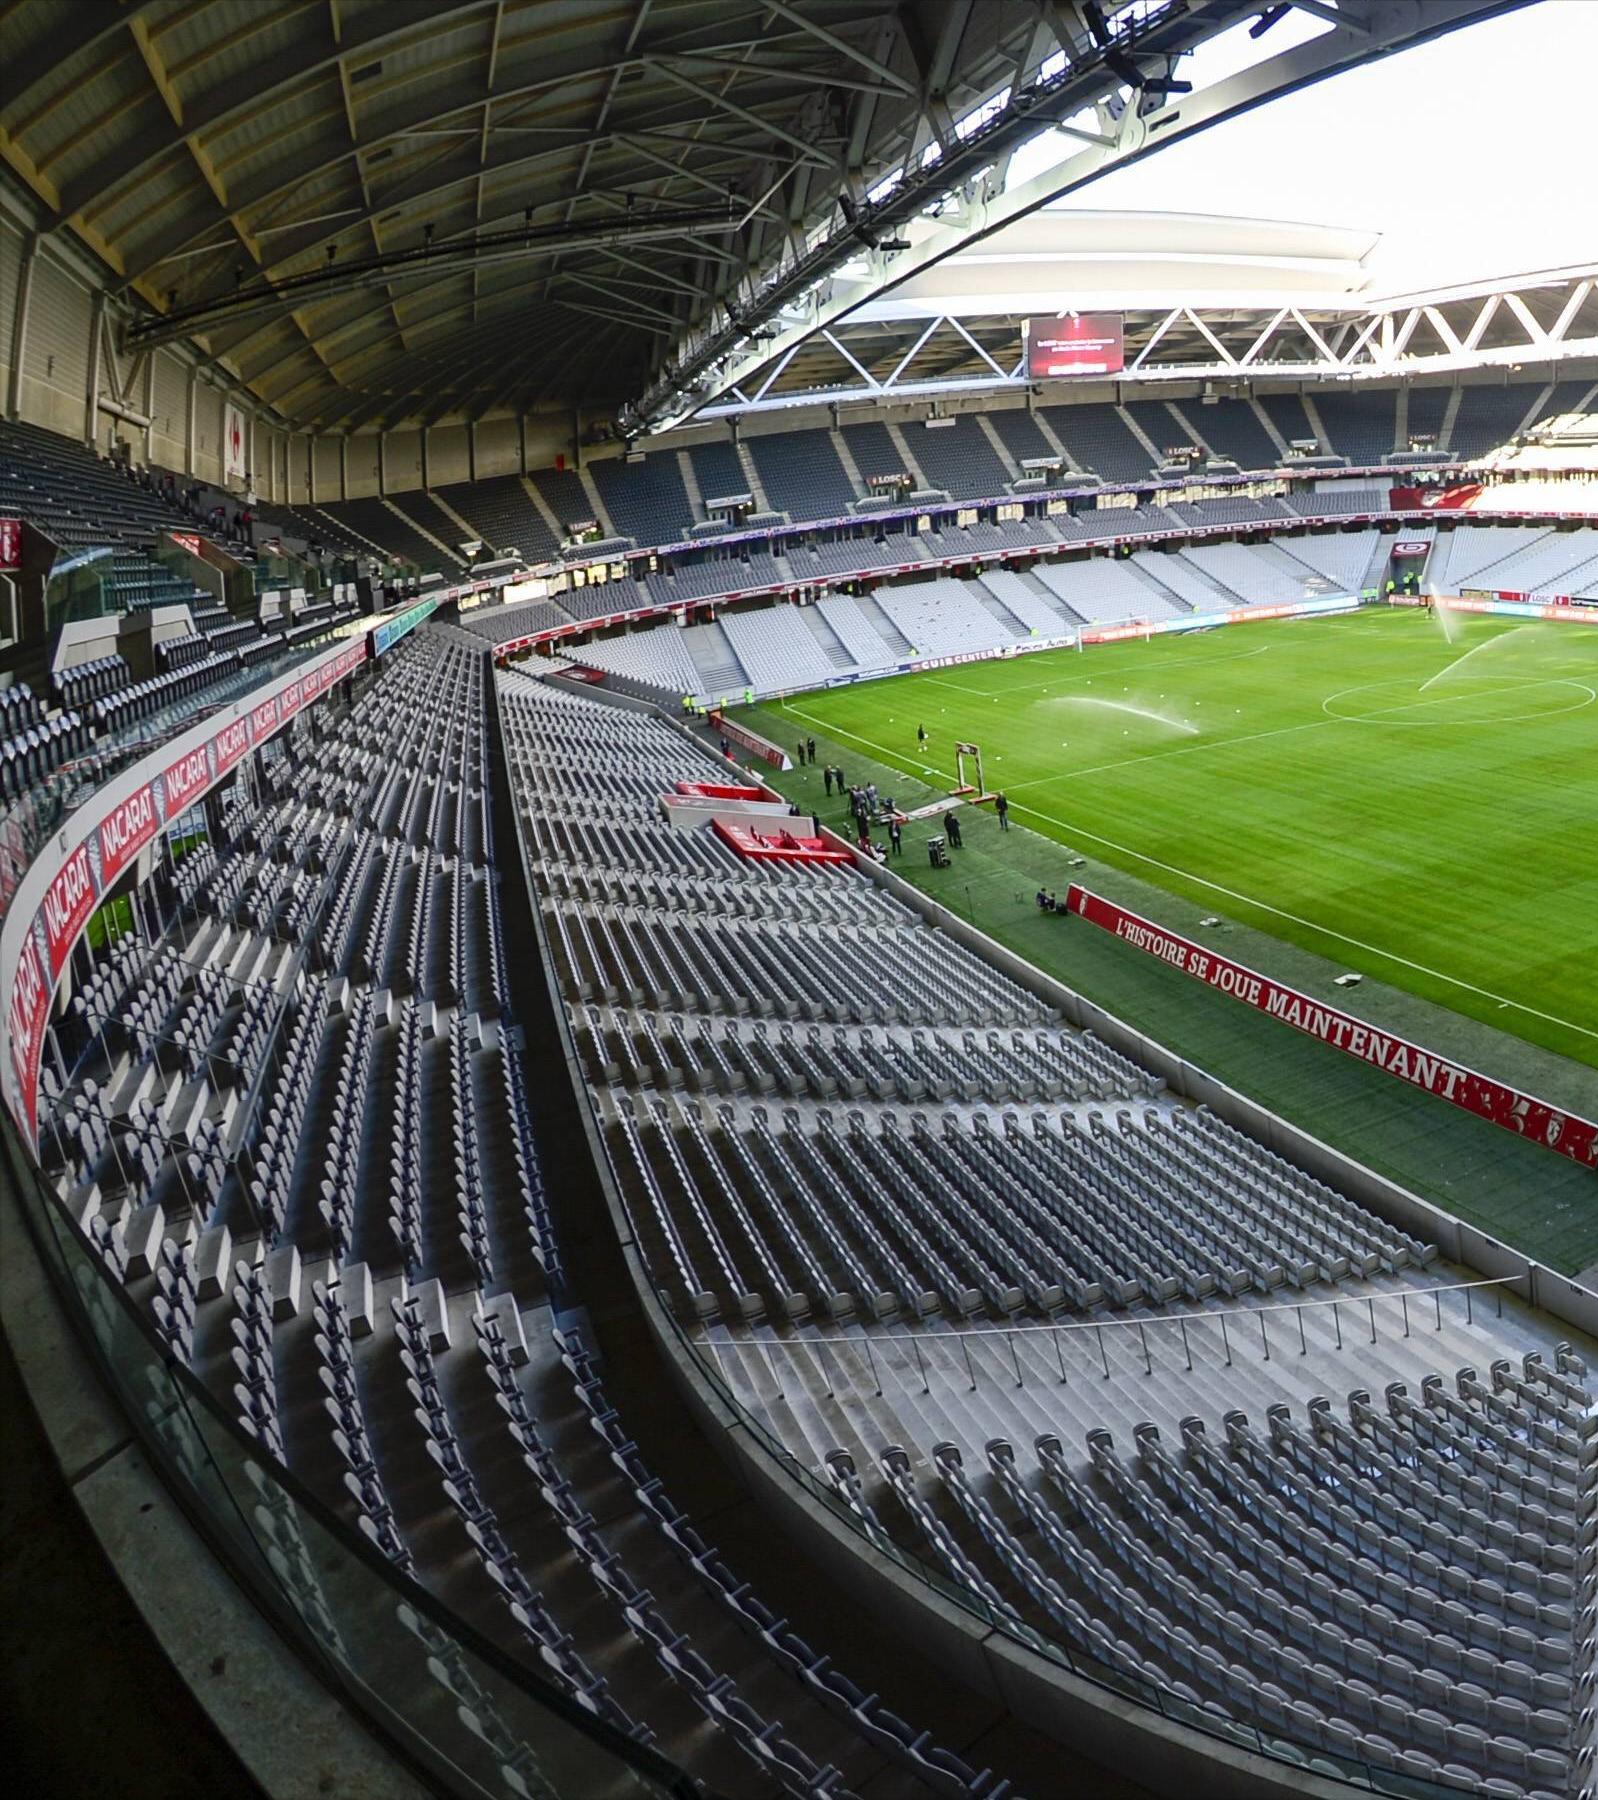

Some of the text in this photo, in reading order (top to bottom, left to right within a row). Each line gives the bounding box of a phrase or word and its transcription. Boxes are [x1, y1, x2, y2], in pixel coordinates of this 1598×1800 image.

[878, 473, 901, 484] LOSC
[921, 650, 996, 670] CUIR CENTER
[216, 720, 247, 761] NACARAT
[166, 748, 207, 803] NACARAT
[102, 787, 153, 862] NACARAT
[44, 846, 89, 947] NACARAT
[1116, 917, 1468, 1100] L'HISTOIRE SE JOUE MAINTENANT
